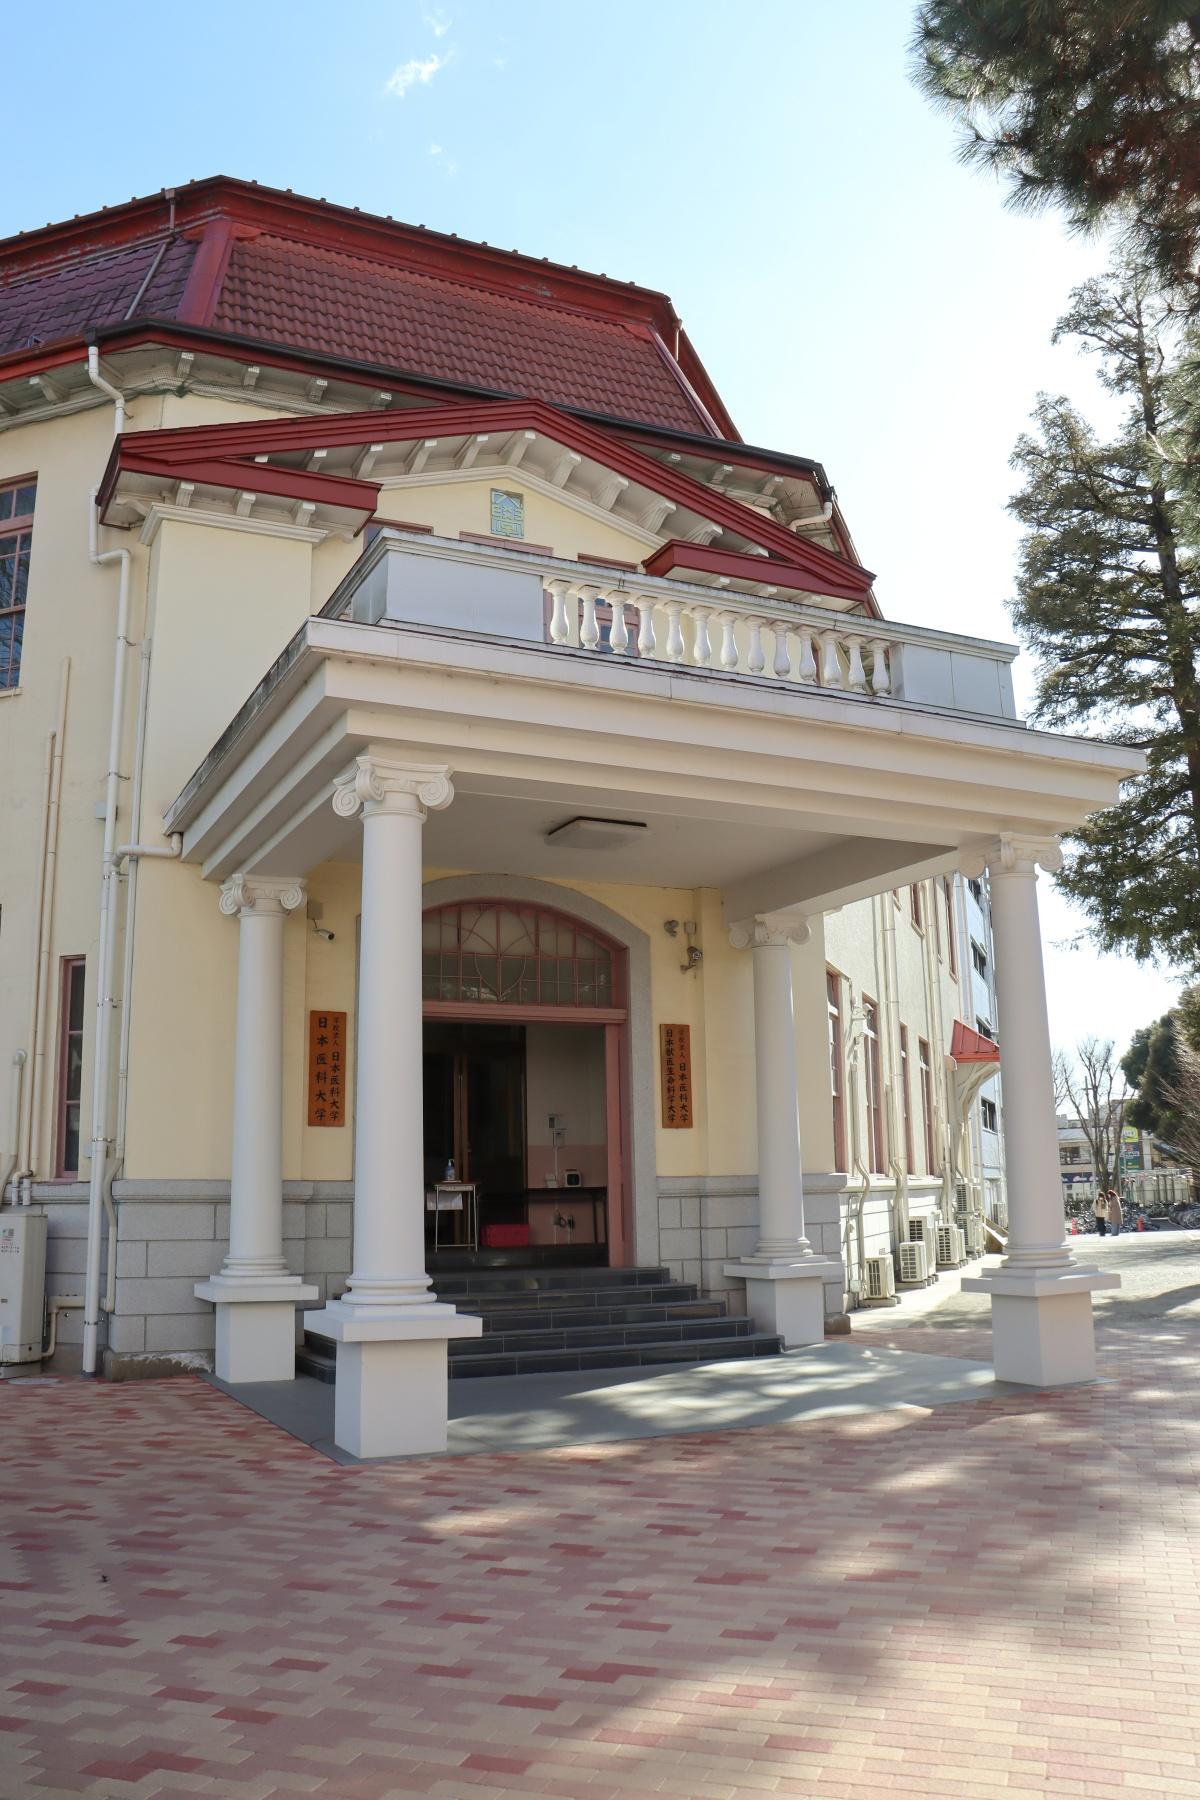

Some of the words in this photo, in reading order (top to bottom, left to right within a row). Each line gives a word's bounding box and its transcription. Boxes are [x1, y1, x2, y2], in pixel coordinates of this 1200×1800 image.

[316, 1017, 328, 1120] 日本医科大学
